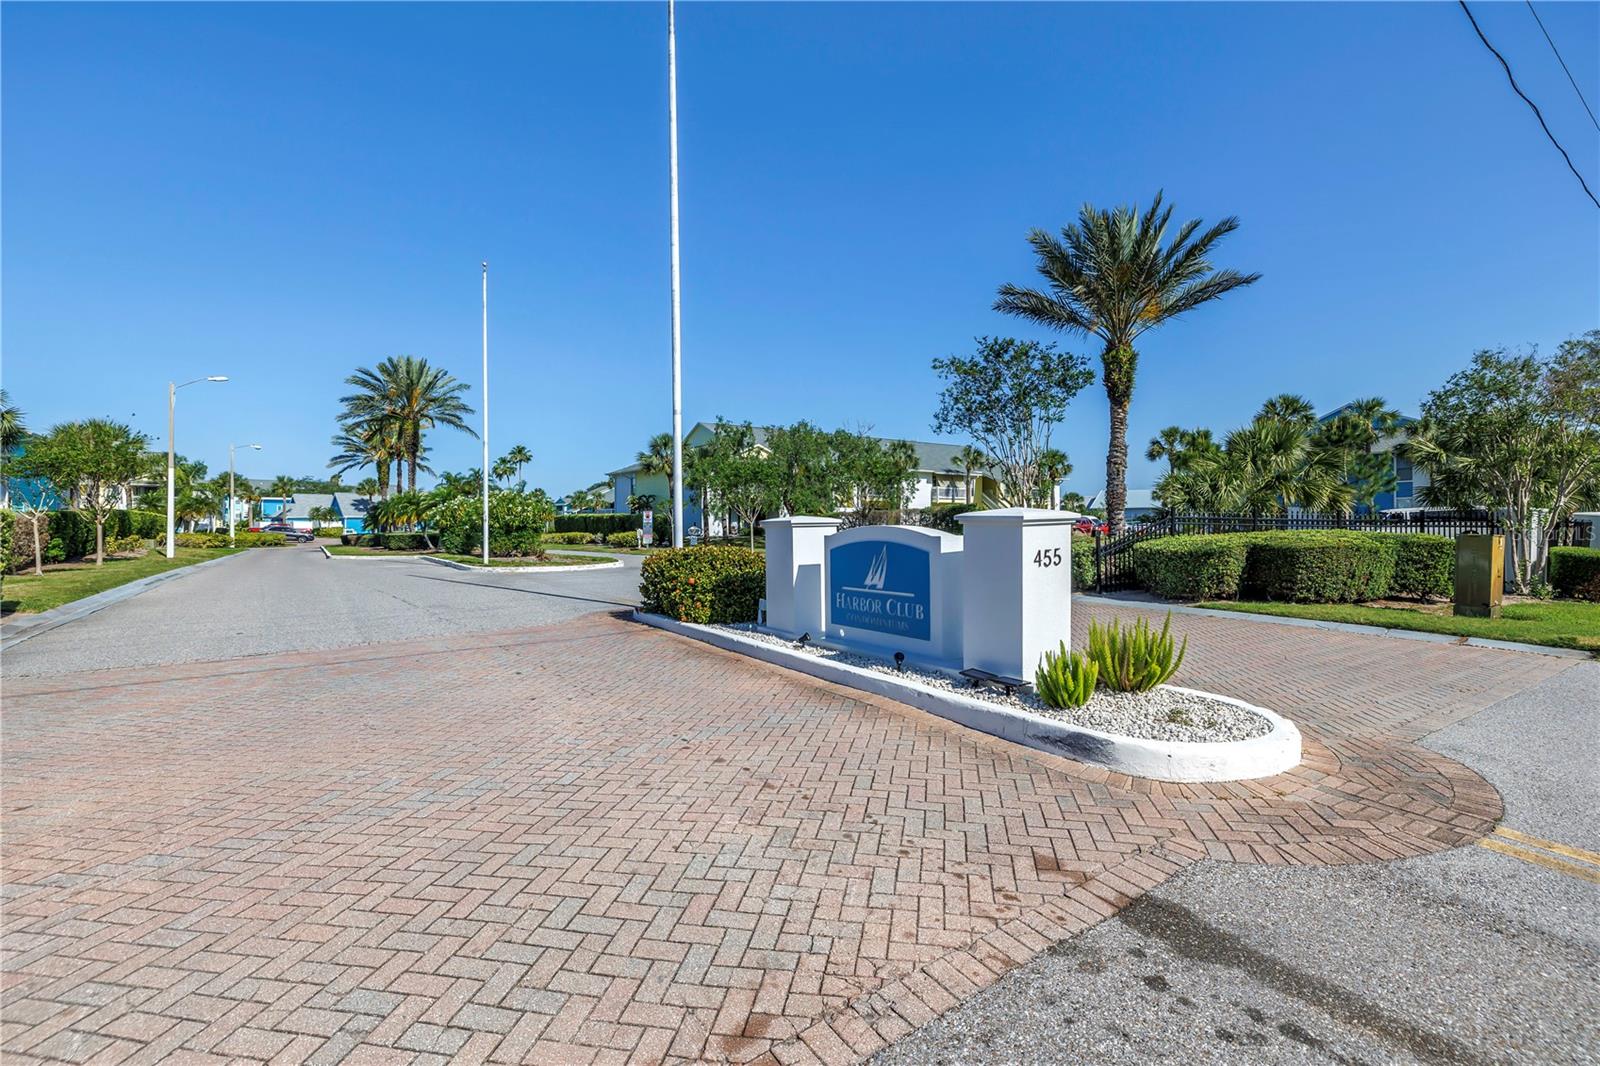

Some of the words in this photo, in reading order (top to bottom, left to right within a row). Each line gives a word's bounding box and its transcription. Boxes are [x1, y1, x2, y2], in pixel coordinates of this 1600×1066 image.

[1033, 547, 1062, 568] 455
[836, 592, 882, 614] HARBOR
[886, 598, 924, 620] CLUB
